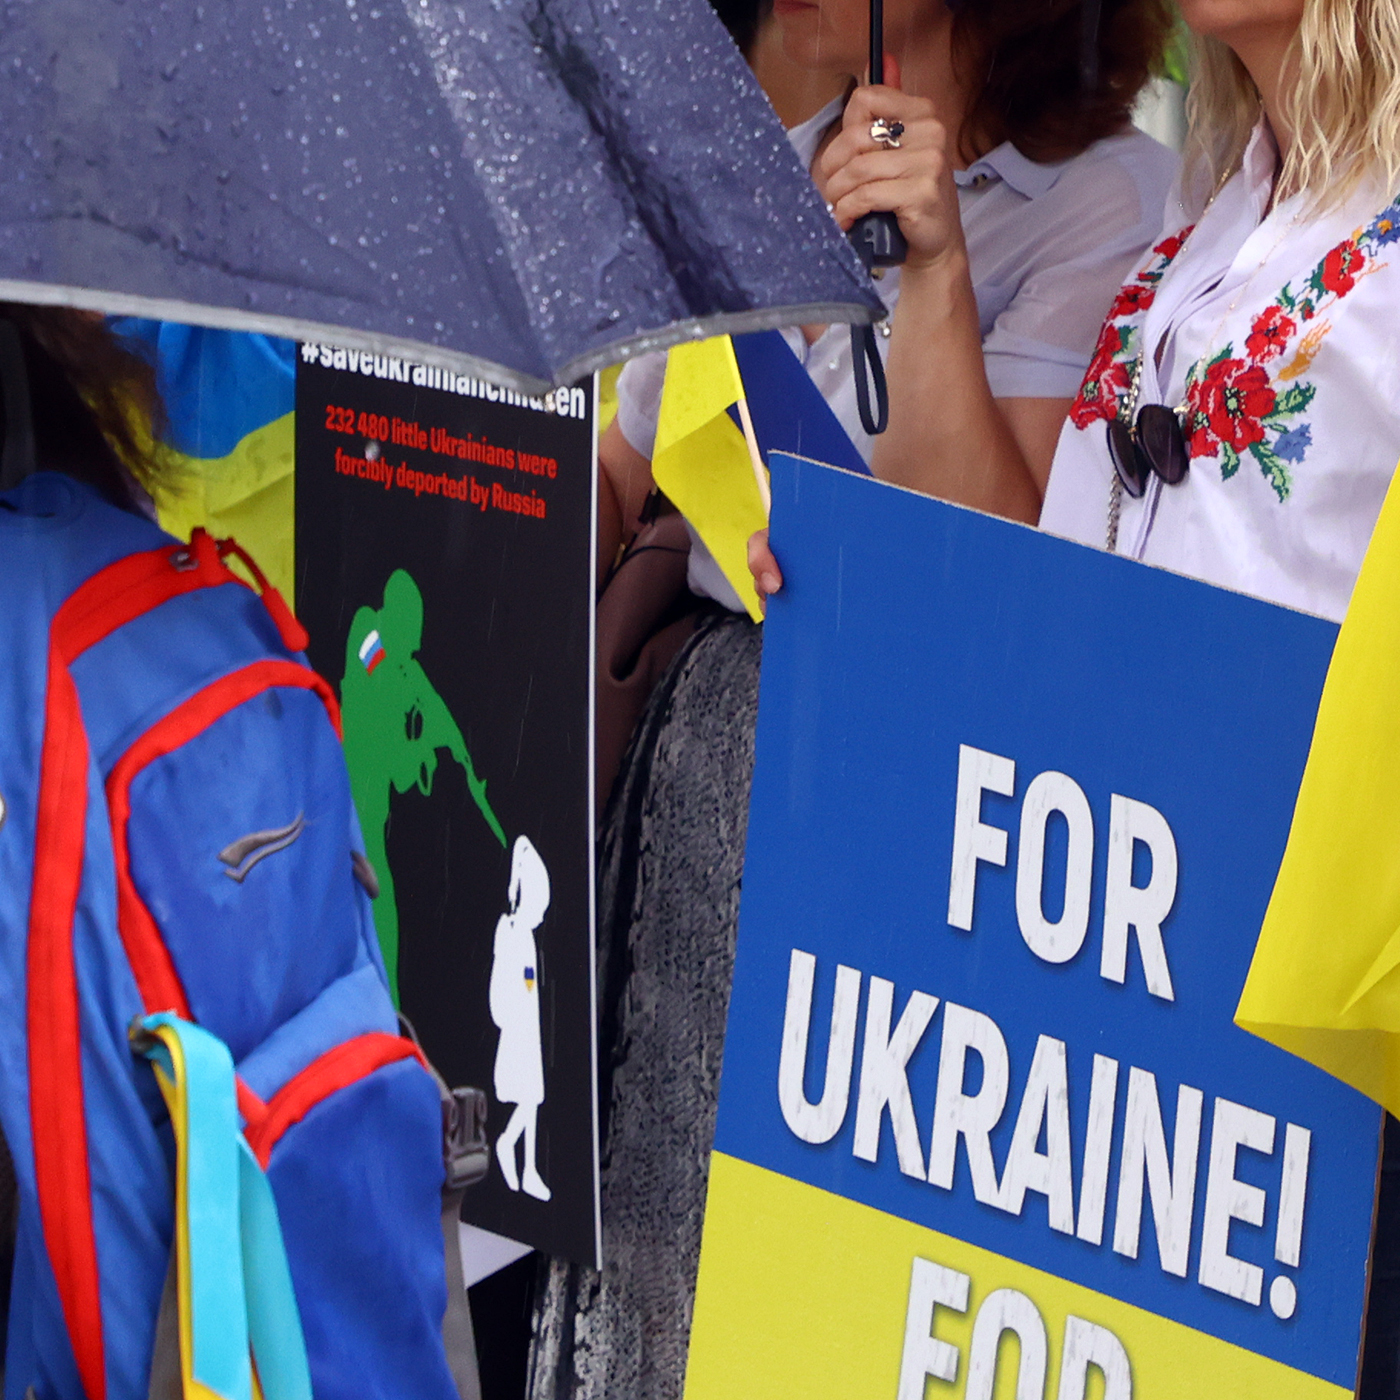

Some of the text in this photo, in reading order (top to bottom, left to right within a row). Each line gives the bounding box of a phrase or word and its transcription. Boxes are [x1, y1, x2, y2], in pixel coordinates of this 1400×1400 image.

[325, 404, 558, 479] 232 480 little Ukrainians were
[334, 446, 547, 519] forcibly deported by Russia
[946, 742, 1179, 1003] FOR
[777, 947, 1312, 1321] UKRAINE!
